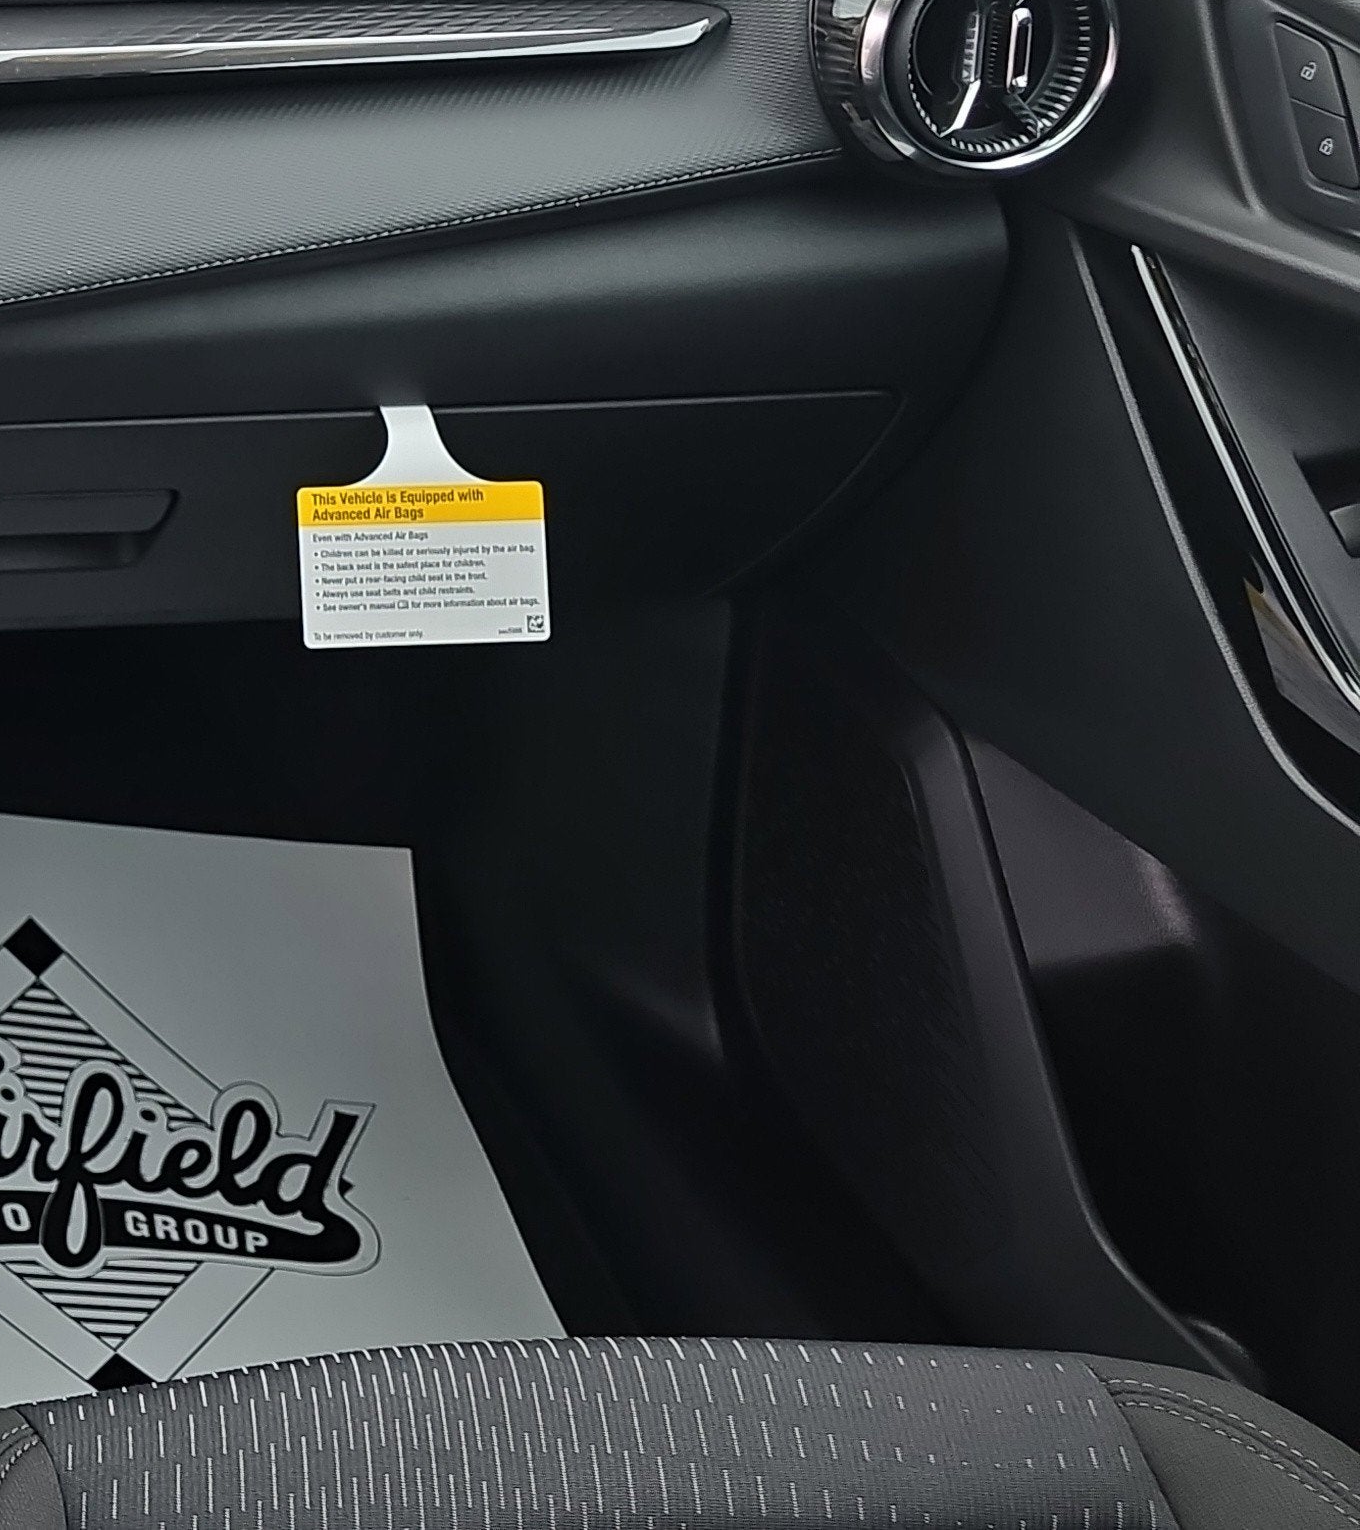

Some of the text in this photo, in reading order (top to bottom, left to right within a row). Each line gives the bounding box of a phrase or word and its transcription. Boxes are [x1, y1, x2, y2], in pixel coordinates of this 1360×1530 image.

[311, 491, 337, 506] This
[339, 490, 383, 506] Vehicle
[399, 489, 455, 506] Equipped
[456, 488, 484, 502] with
[312, 506, 424, 522] Advanced Air Bags
[312, 530, 429, 543] Even with Advanced Air Bags
[124, 1213, 269, 1254] GROUP
